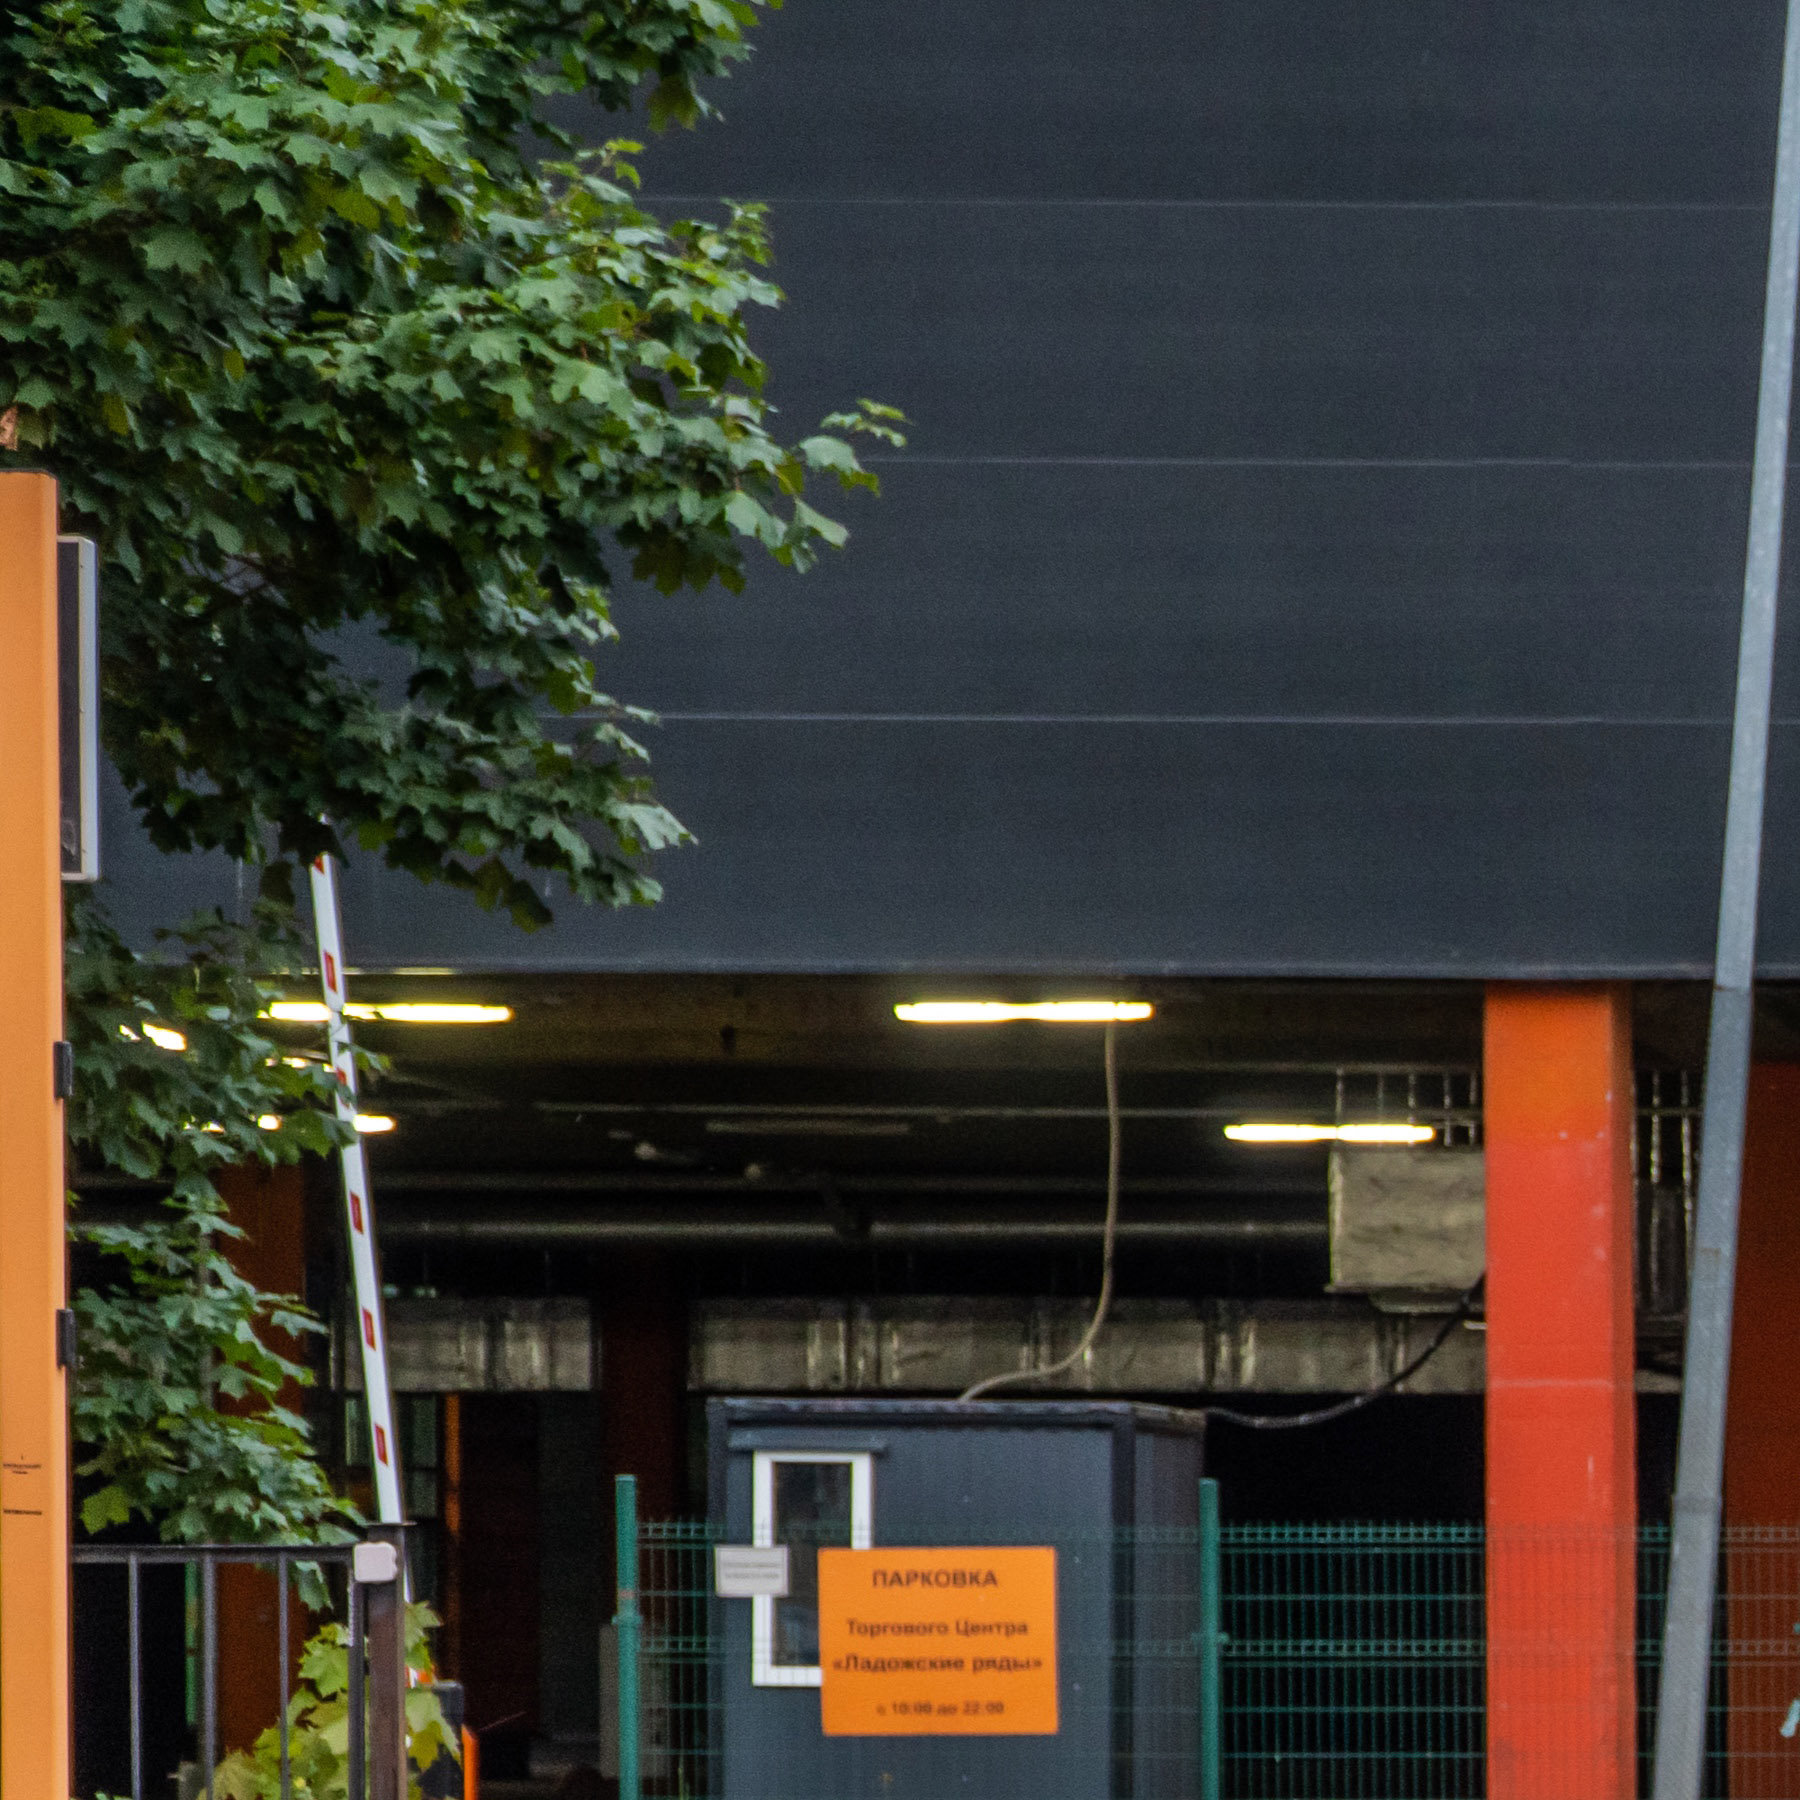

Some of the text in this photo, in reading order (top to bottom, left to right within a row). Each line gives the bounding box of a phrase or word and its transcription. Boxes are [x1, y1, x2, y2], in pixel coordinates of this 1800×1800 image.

[872, 1569, 998, 1588] ПАРКОВКА
[847, 1618, 1029, 1639] Торгового Центра
